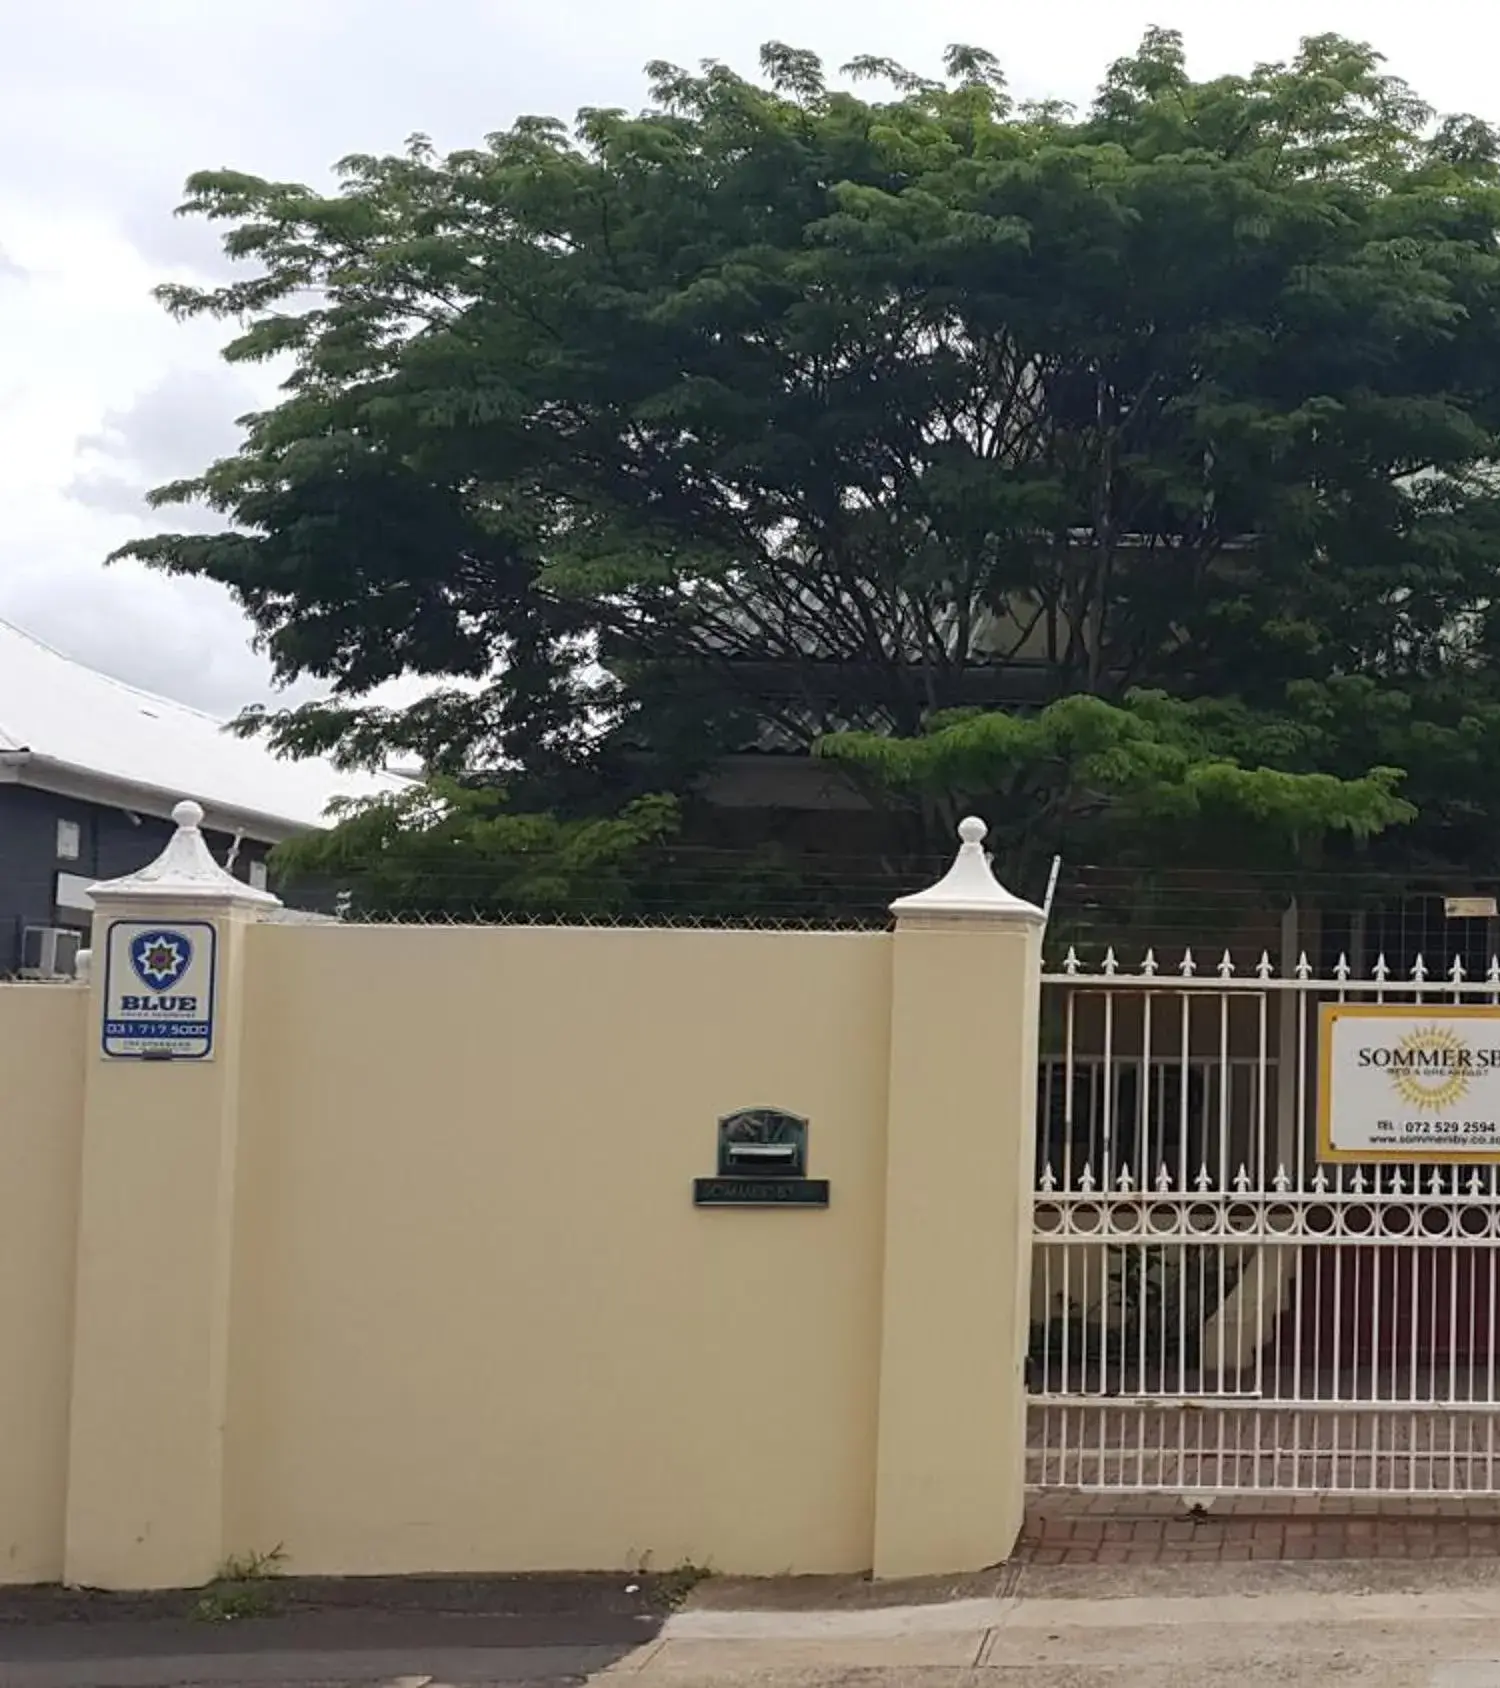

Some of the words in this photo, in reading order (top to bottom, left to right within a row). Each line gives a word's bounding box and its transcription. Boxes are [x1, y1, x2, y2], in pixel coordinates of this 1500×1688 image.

[121, 996, 197, 1011] BLUE
[106, 1023, 134, 1035] 031
[139, 1024, 167, 1035] 717
[171, 1024, 209, 1036] 5000
[1405, 1121, 1431, 1133] 072
[1434, 1121, 1460, 1133] 529
[1463, 1121, 1497, 1133] 2594
